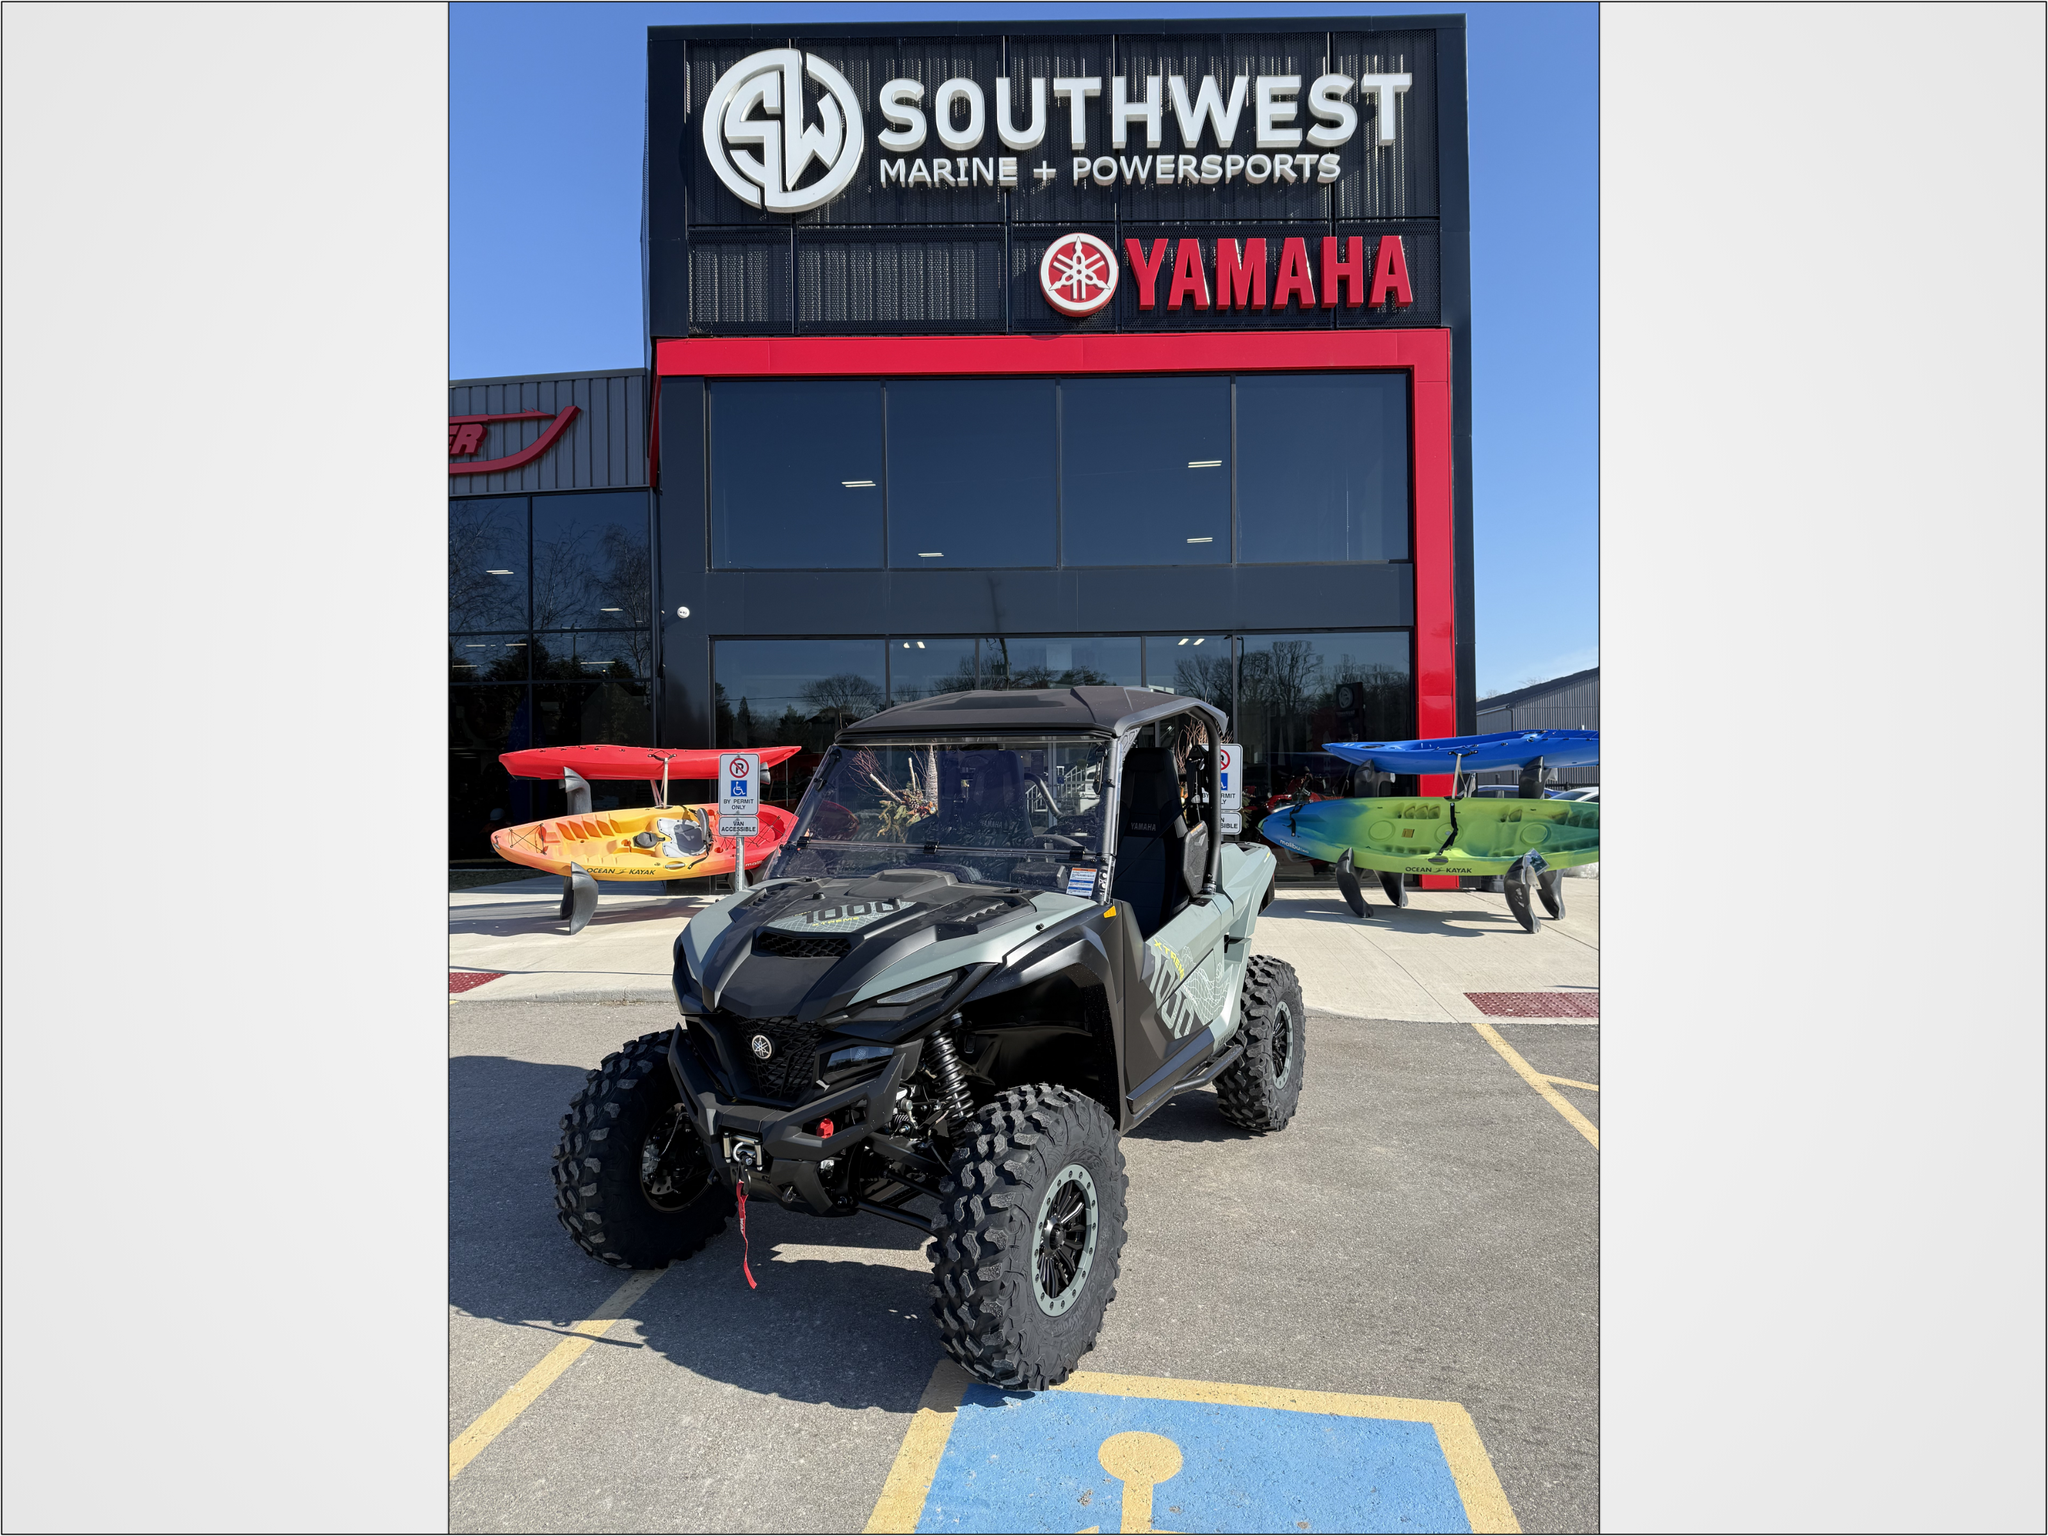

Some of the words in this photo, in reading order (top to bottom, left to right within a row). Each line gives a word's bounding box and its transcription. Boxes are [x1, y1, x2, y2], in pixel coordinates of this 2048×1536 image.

[878, 72, 1413, 152] SOUTHWEST
[879, 157, 1018, 188] MARINE
[1072, 153, 1342, 187] POWERSPORTS
[1124, 235, 1413, 310] YAMAHA
[1130, 822, 1157, 832] YAMAHA
[586, 867, 616, 875] OCEAN
[628, 868, 656, 876] KAYAK
[805, 901, 901, 924] 1000
[1153, 938, 1185, 982] XTREM
